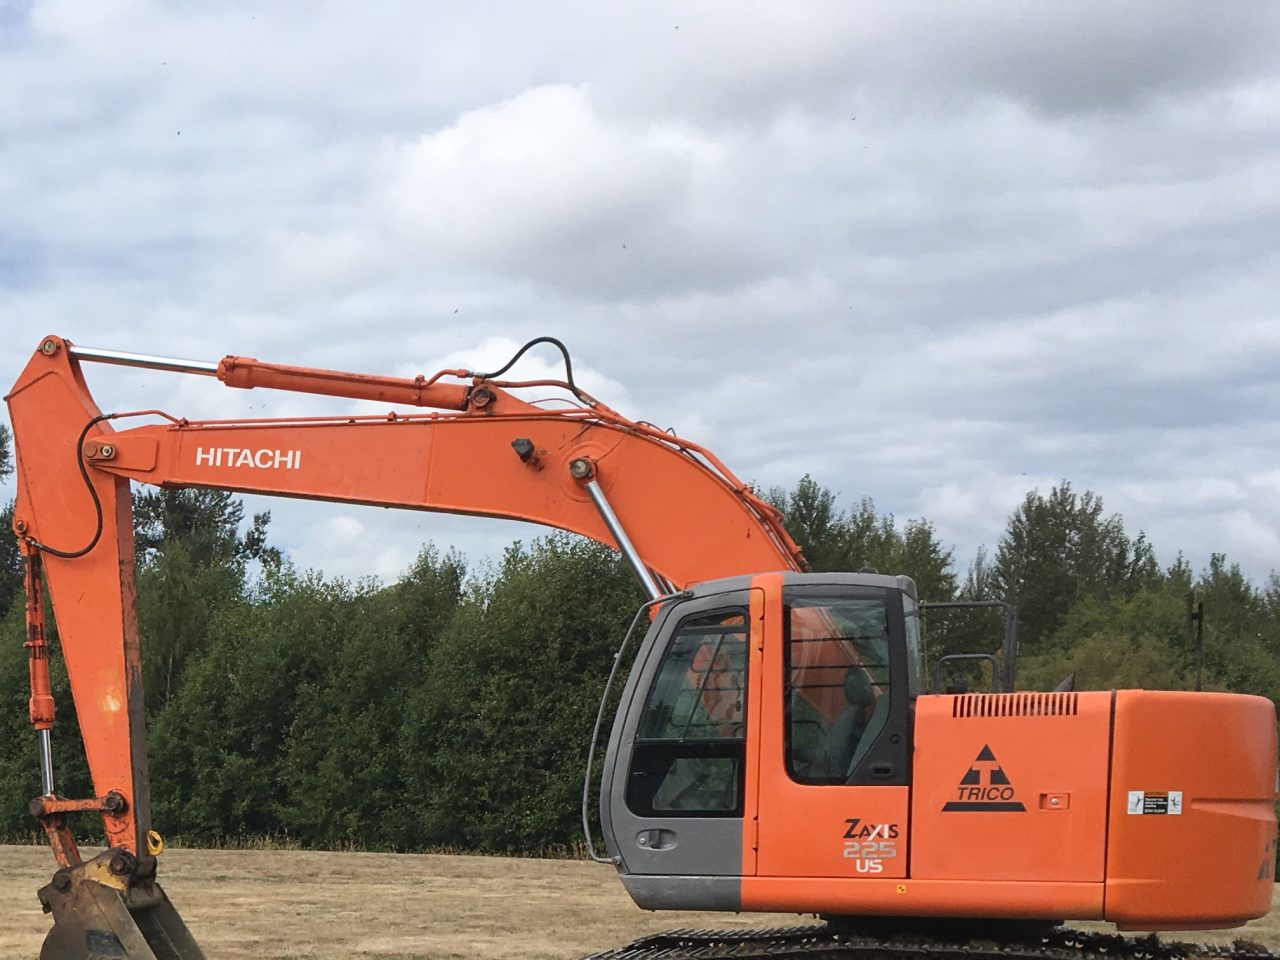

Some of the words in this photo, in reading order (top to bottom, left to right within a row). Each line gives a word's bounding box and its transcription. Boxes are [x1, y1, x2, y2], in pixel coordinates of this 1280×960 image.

[196, 447, 301, 469] HITACHI
[957, 787, 1014, 801] TRICO
[843, 841, 896, 858] 225
[856, 859, 883, 873] US
